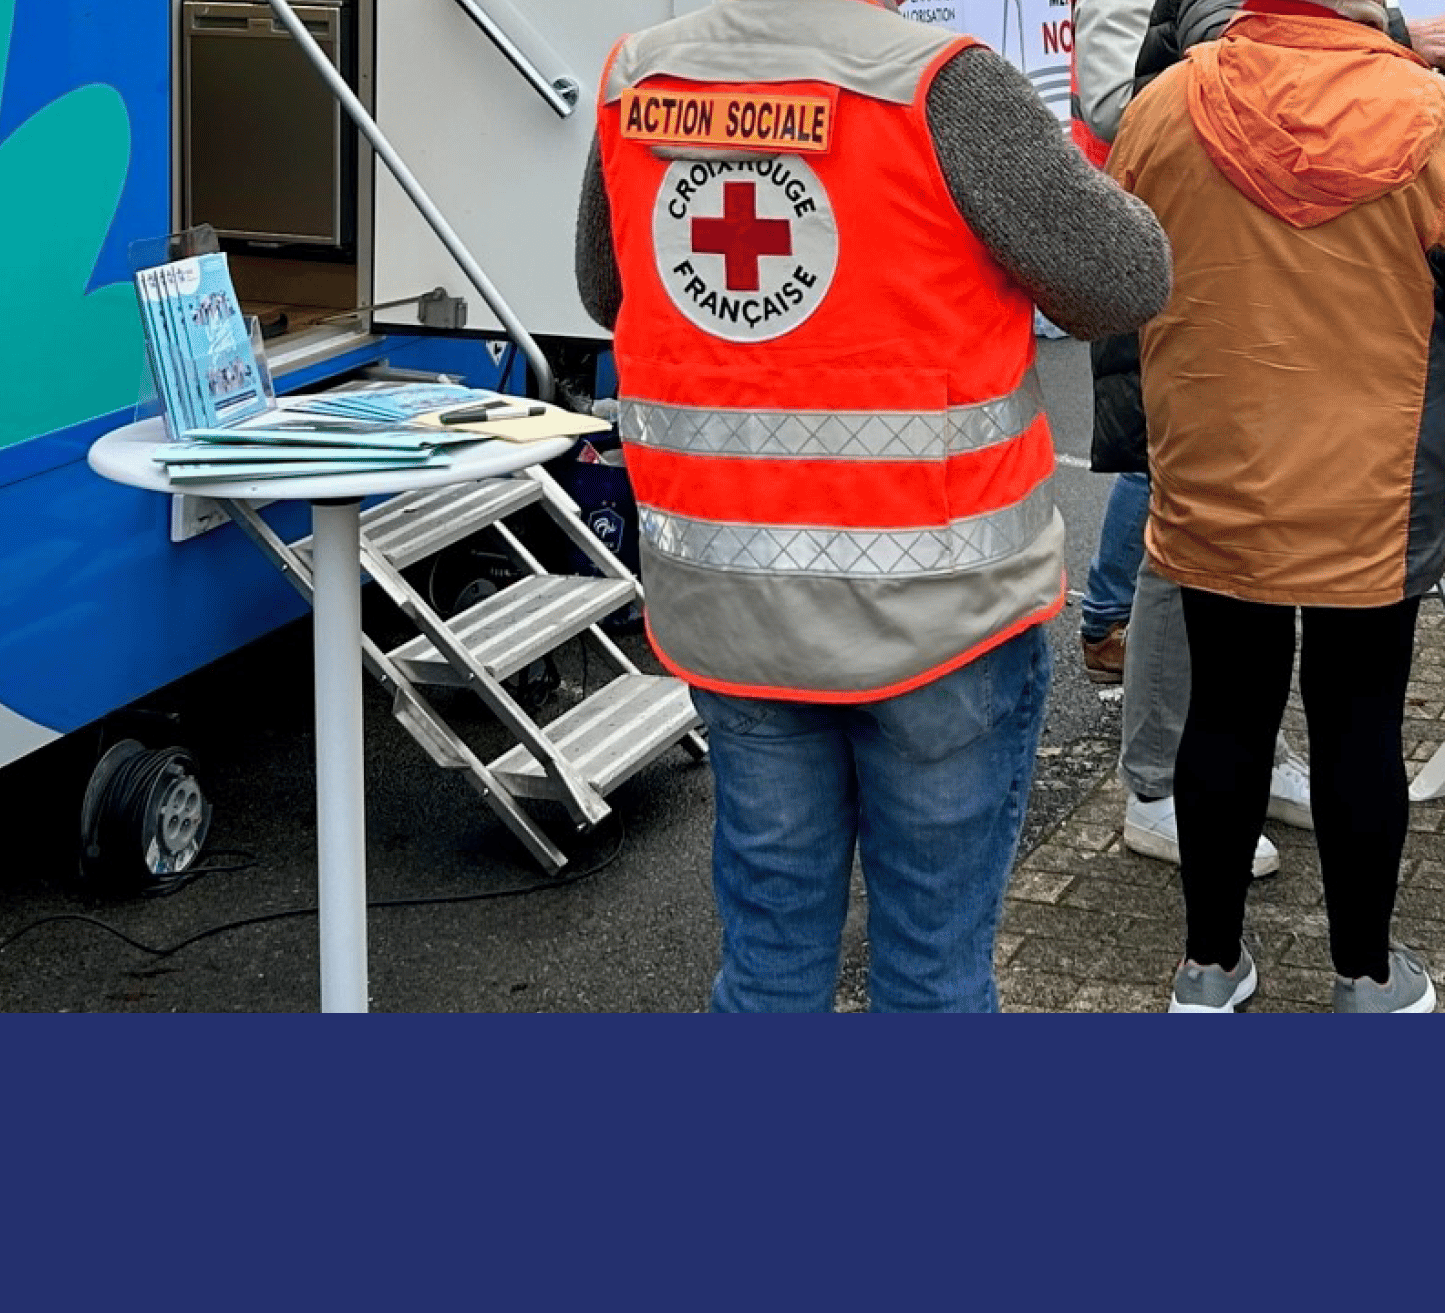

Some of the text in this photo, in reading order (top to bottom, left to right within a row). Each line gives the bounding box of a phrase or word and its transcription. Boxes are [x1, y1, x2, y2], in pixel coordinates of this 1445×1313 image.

[1042, 20, 1073, 55] NO
[627, 96, 825, 143] ACTION SOCIALE
[673, 259, 818, 329] FRANÇAISE
